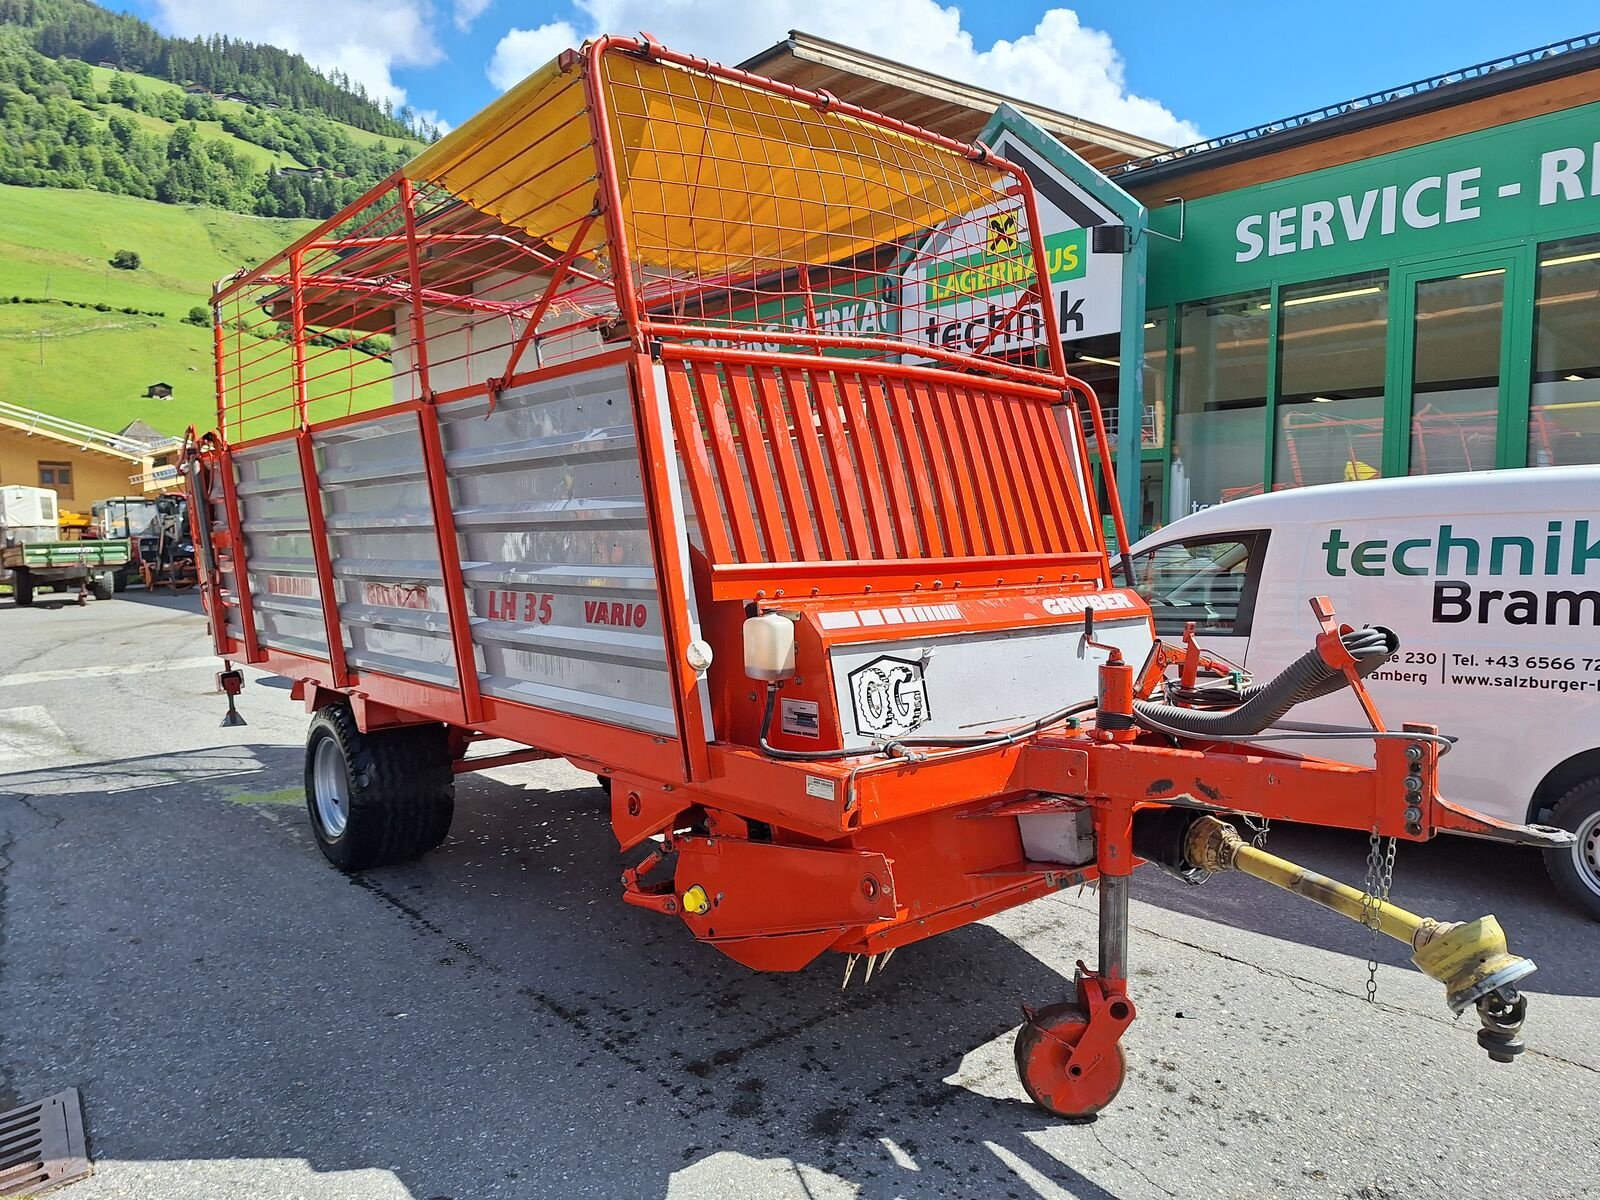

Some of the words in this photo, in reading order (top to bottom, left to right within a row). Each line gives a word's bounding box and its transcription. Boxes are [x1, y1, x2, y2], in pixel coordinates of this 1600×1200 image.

[1235, 166, 1482, 263] SERVICE
[1539, 140, 1600, 206] R
[925, 289, 1086, 352] technk
[487, 590, 517, 621] LH
[524, 592, 554, 625] 35
[584, 600, 648, 629] VARIO
[1041, 593, 1136, 616] GRUBER
[1405, 652, 1437, 665] 230
[1452, 653, 1479, 667] Tel.
[1484, 655, 1520, 669] +43
[1525, 656, 1576, 671] 6566
